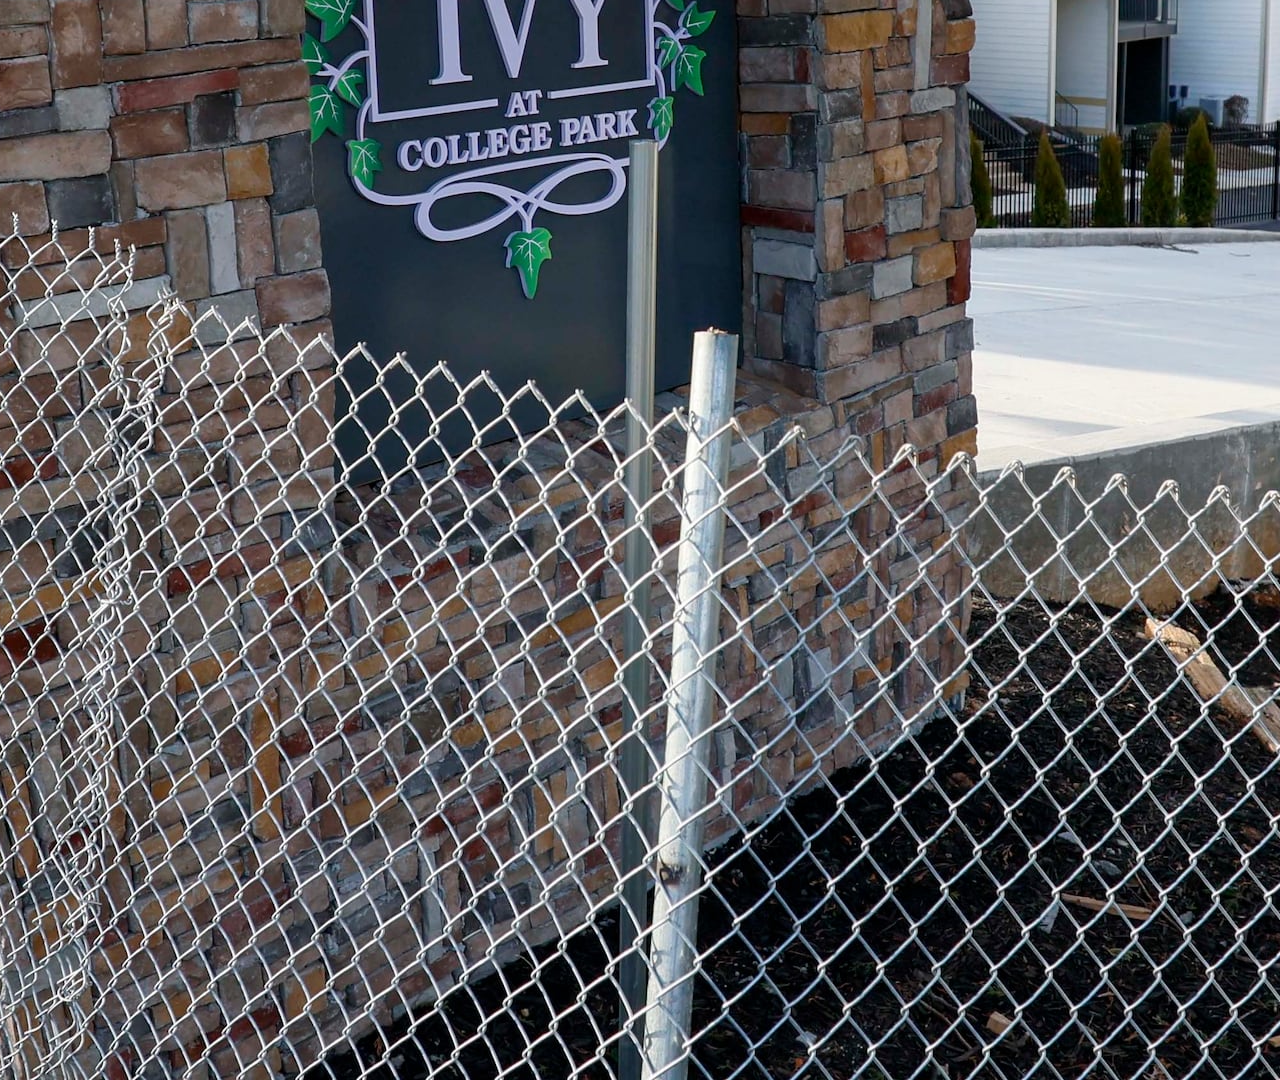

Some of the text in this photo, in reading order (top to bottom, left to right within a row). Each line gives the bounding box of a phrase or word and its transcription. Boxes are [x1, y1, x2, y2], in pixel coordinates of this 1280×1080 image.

[506, 90, 542, 117] AT
[398, 110, 638, 171] COLLEGE PARK
